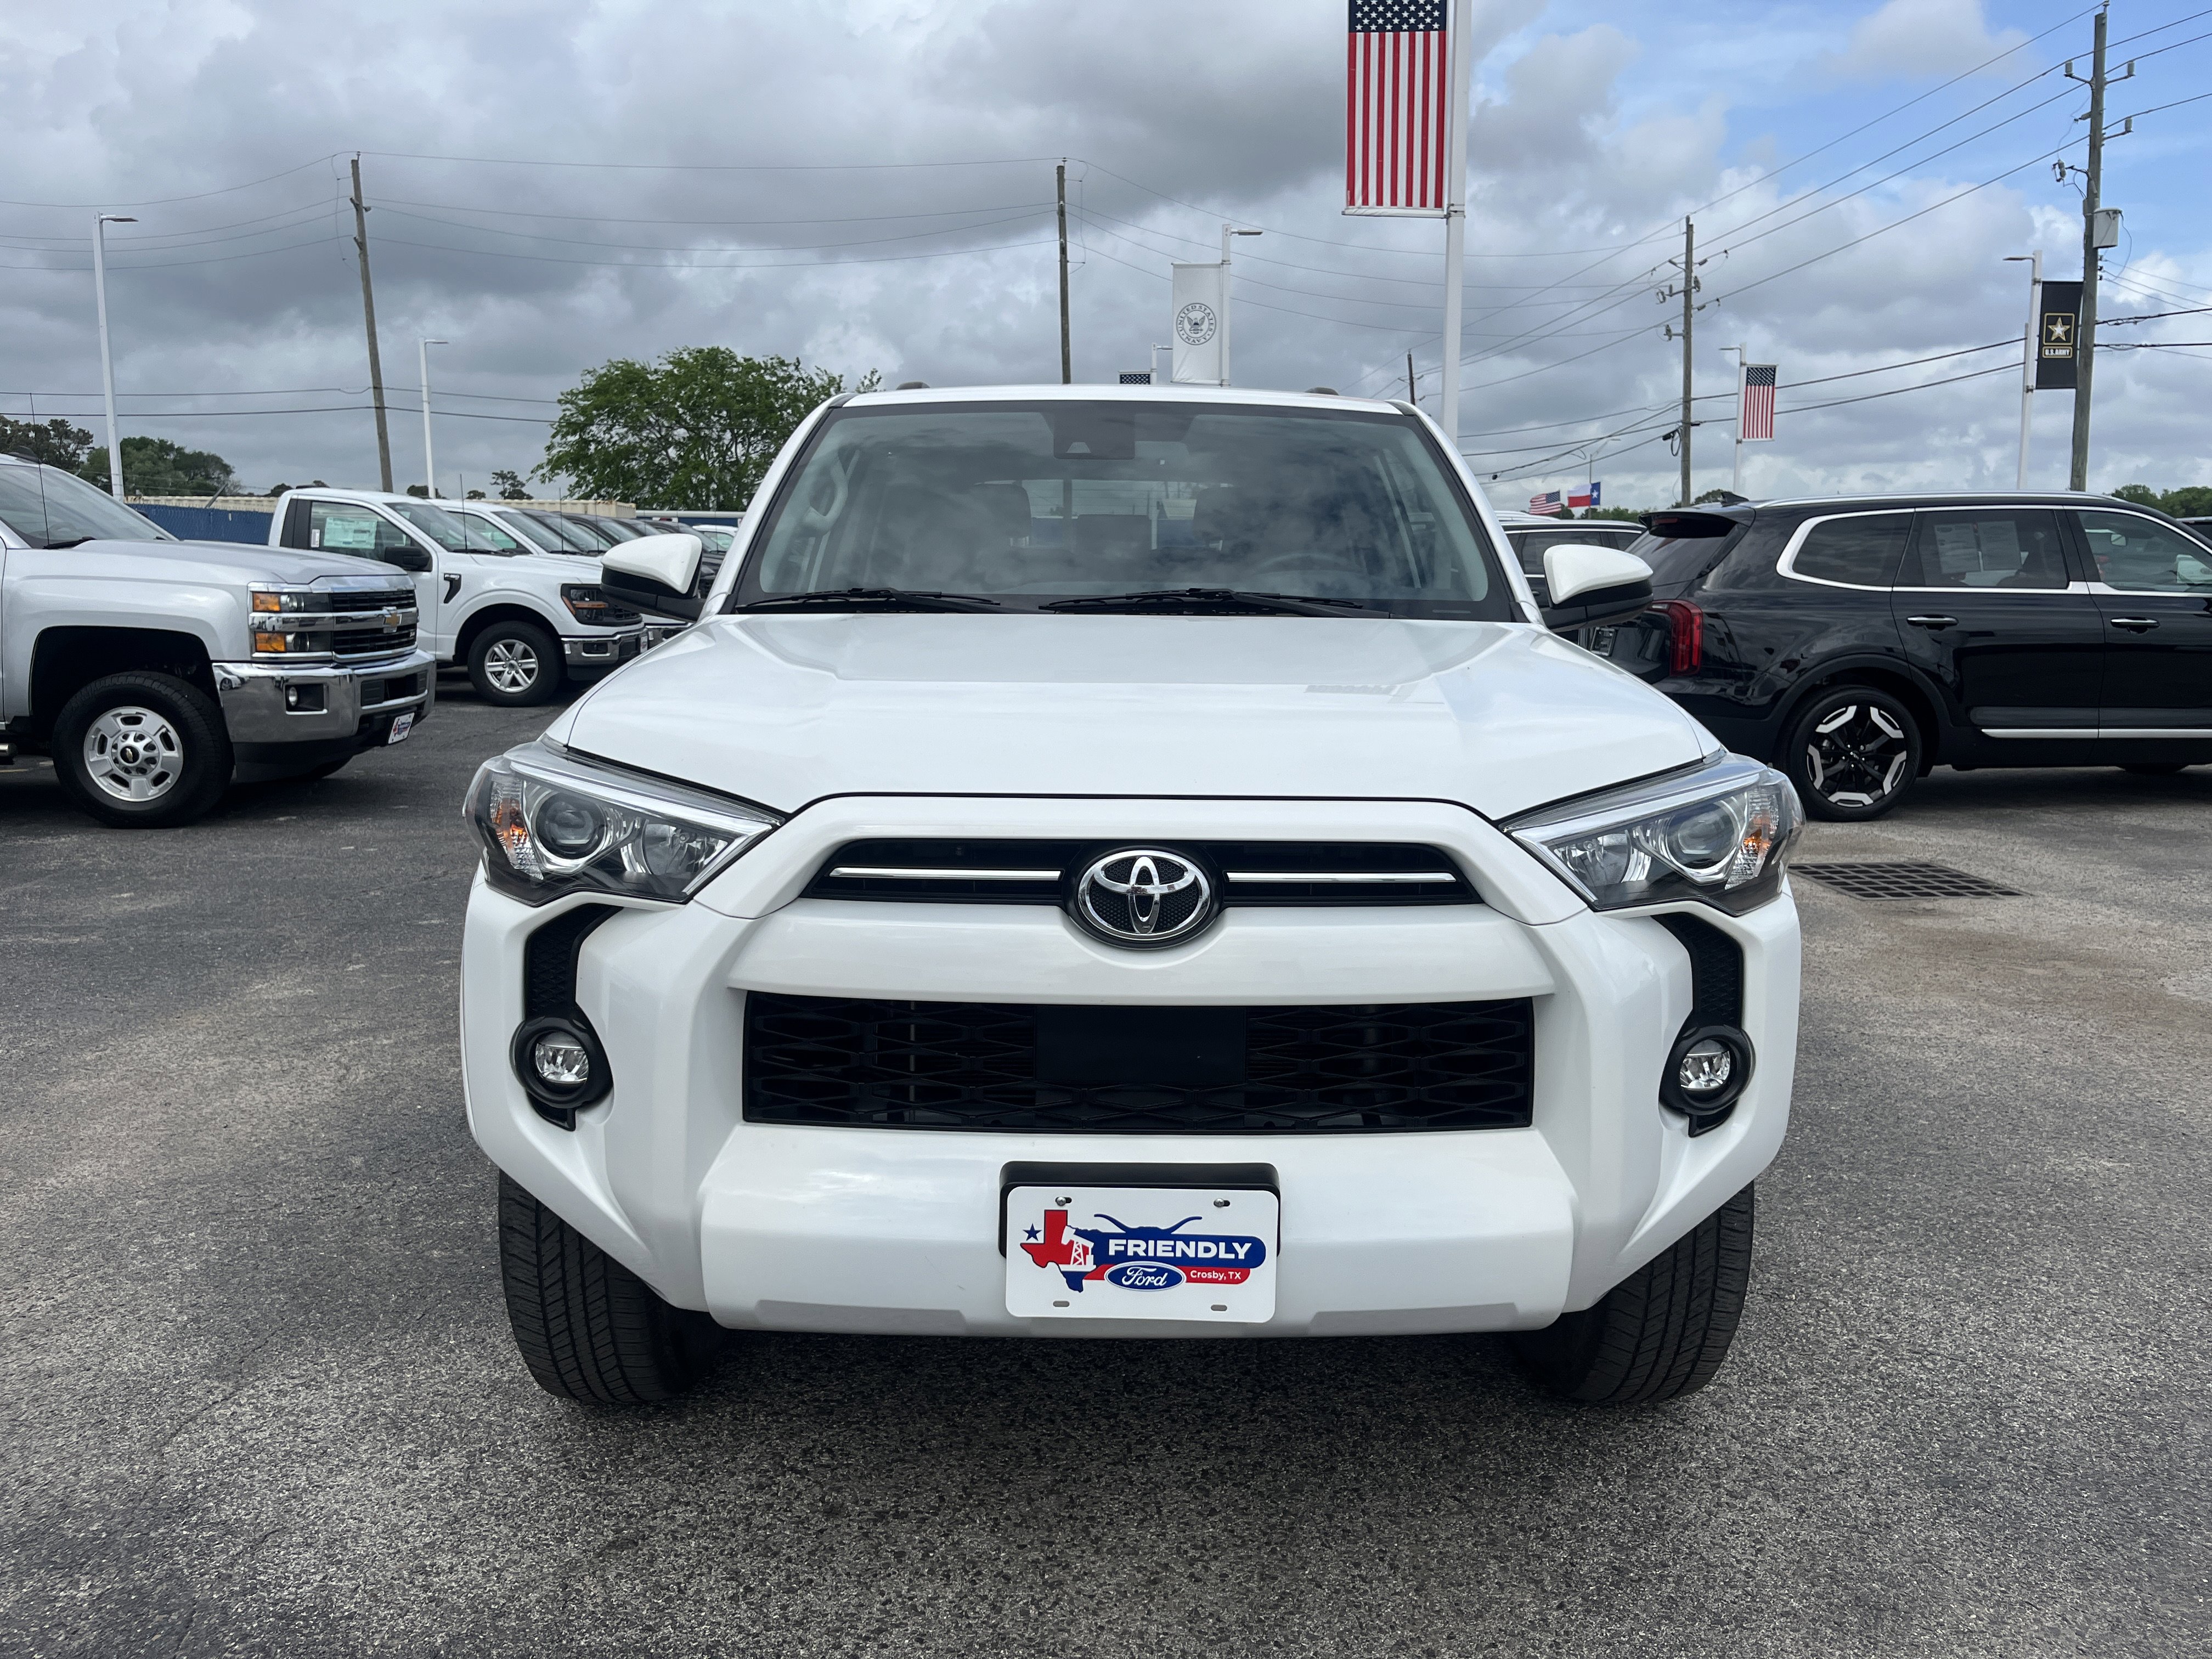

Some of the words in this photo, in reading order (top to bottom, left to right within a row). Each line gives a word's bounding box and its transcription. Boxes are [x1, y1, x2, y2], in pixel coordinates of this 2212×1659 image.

[1178, 305, 1197, 331] UNITED
[1198, 305, 1214, 331] STATES
[1108, 1239, 1252, 1260] FRIENDLY
[1121, 1266, 1168, 1286] Ford
[1190, 1270, 1226, 1280] Crosby,
[1228, 1271, 1242, 1280] TX
